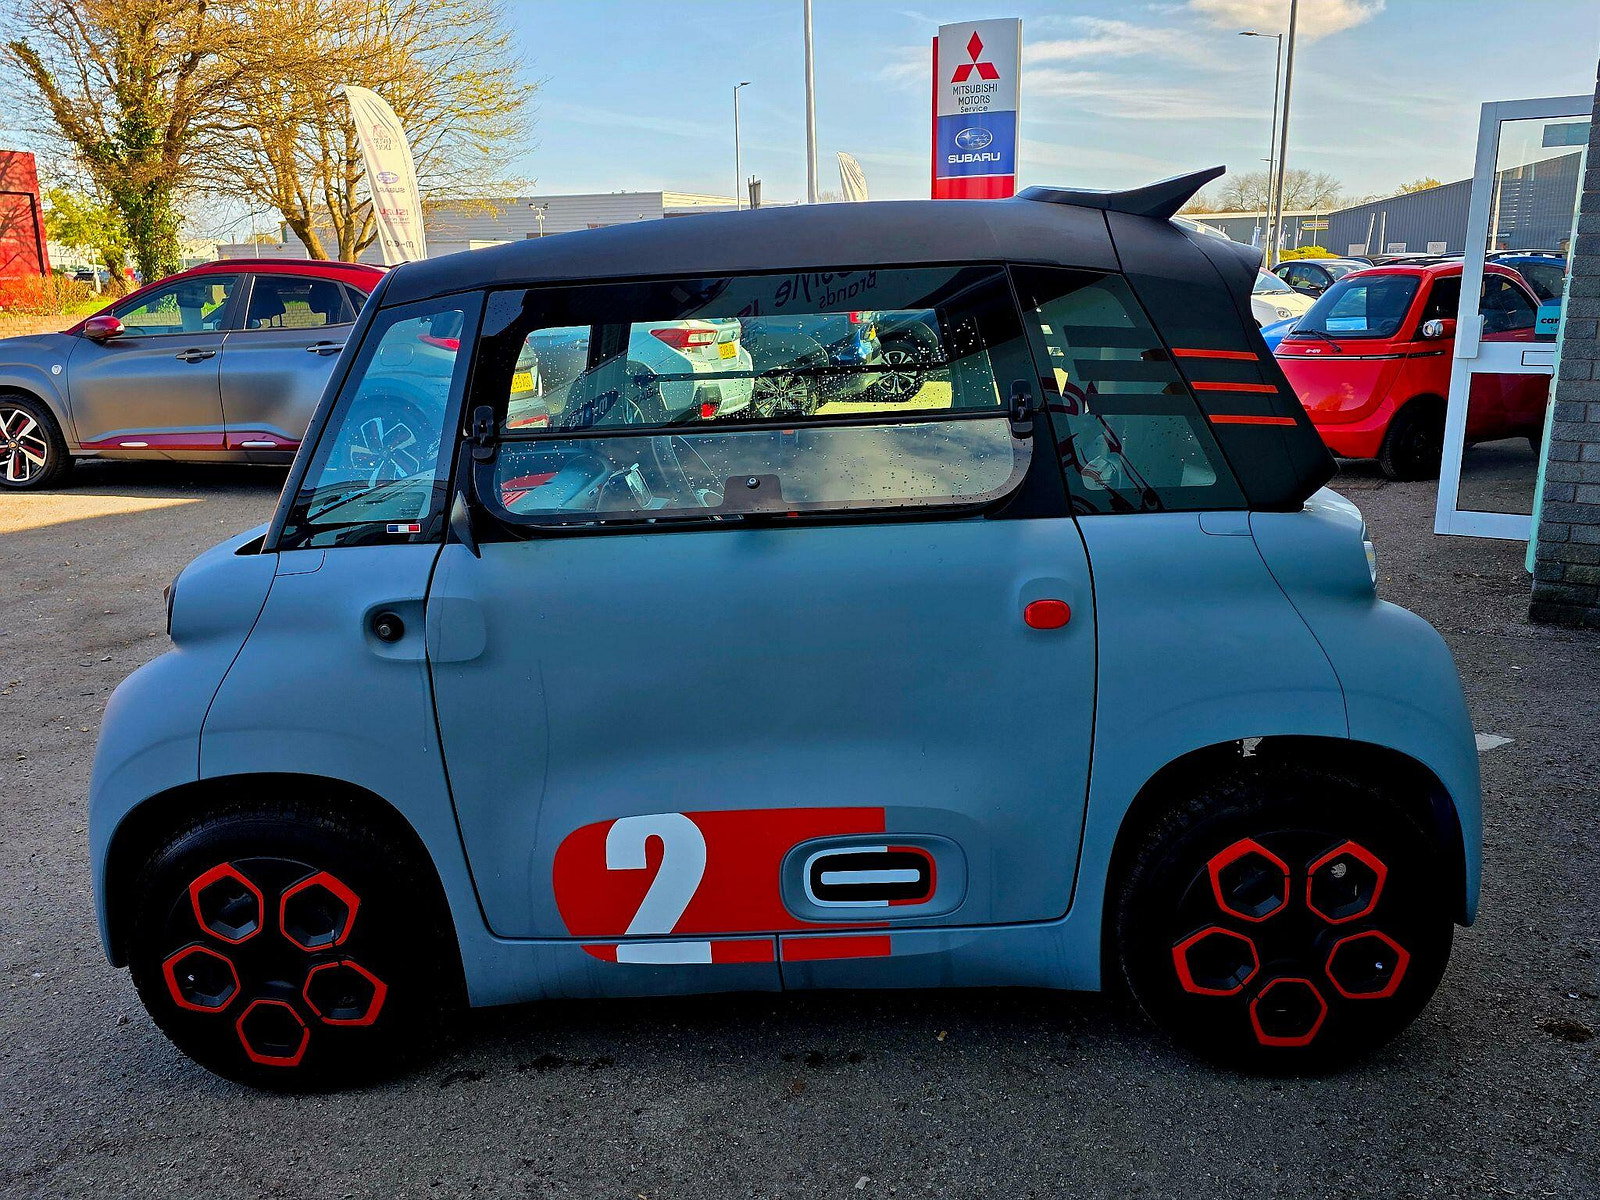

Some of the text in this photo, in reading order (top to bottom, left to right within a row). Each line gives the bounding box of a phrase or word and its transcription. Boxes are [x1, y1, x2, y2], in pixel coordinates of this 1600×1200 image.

[952, 83, 998, 95] MITSUBISHI
[958, 95, 991, 105] MOTORS
[960, 105, 988, 113] Service
[948, 152, 1001, 163] SUBARU
[605, 812, 713, 965] 2
